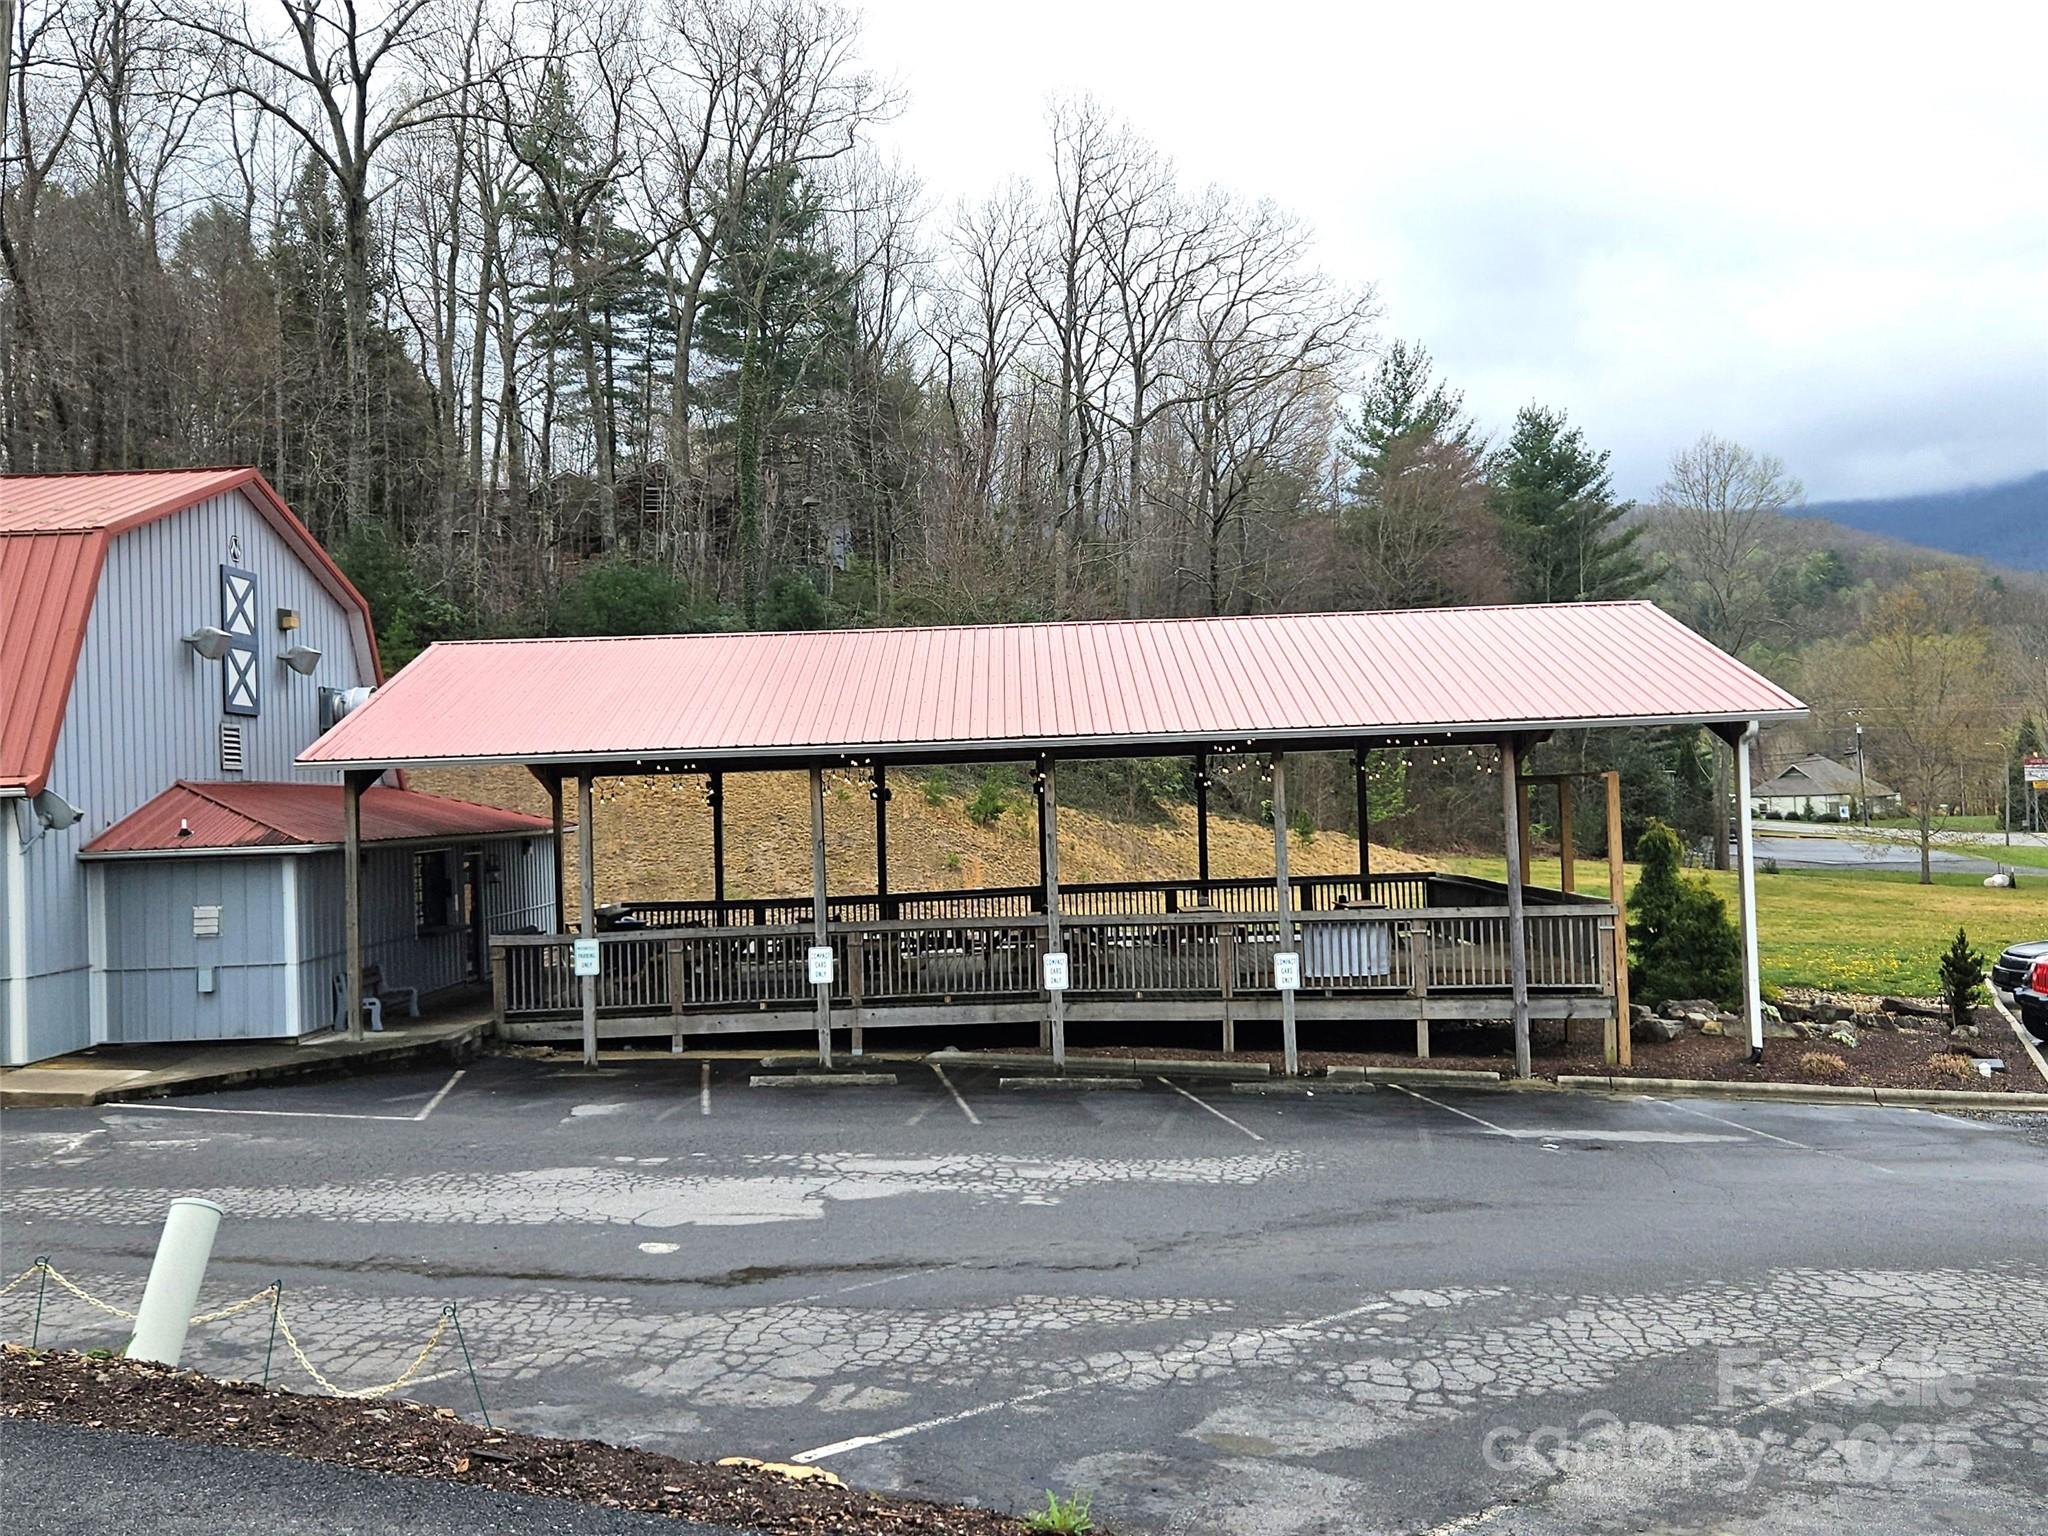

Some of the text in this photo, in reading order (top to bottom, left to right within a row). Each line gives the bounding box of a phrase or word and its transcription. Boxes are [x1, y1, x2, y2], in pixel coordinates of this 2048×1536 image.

[811, 952, 831, 960] COMPACT
[814, 961, 827, 969] CARS
[1046, 958, 1066, 967] COMPACT
[1276, 958, 1296, 966] COMPACT
[1050, 967, 1062, 975] CARS
[1280, 967, 1293, 975] CARS
[1281, 976, 1293, 984] ONLY
